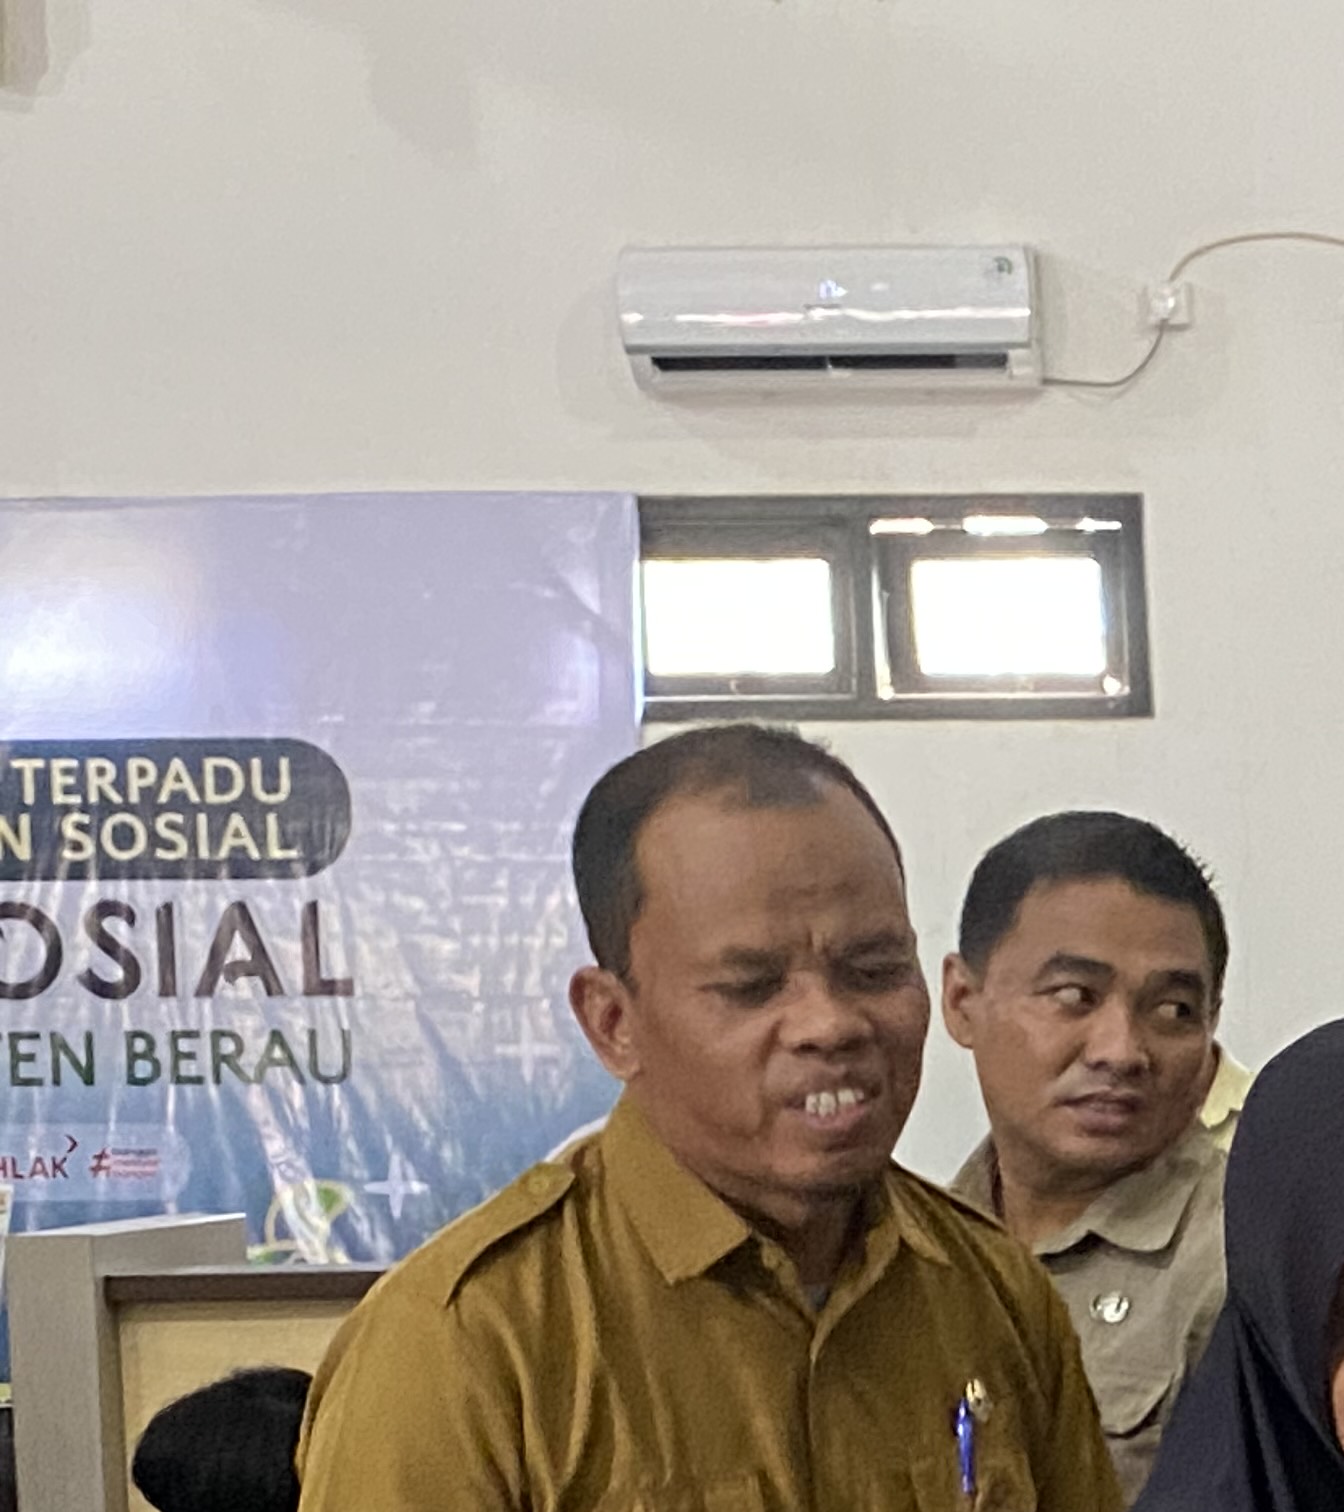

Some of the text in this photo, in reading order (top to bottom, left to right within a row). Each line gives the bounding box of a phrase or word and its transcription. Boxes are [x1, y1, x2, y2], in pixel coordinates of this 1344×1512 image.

[10, 757, 291, 805] TERPADU
[61, 811, 299, 862] SOSIAL
[0, 1028, 351, 1086] EN BERAU
